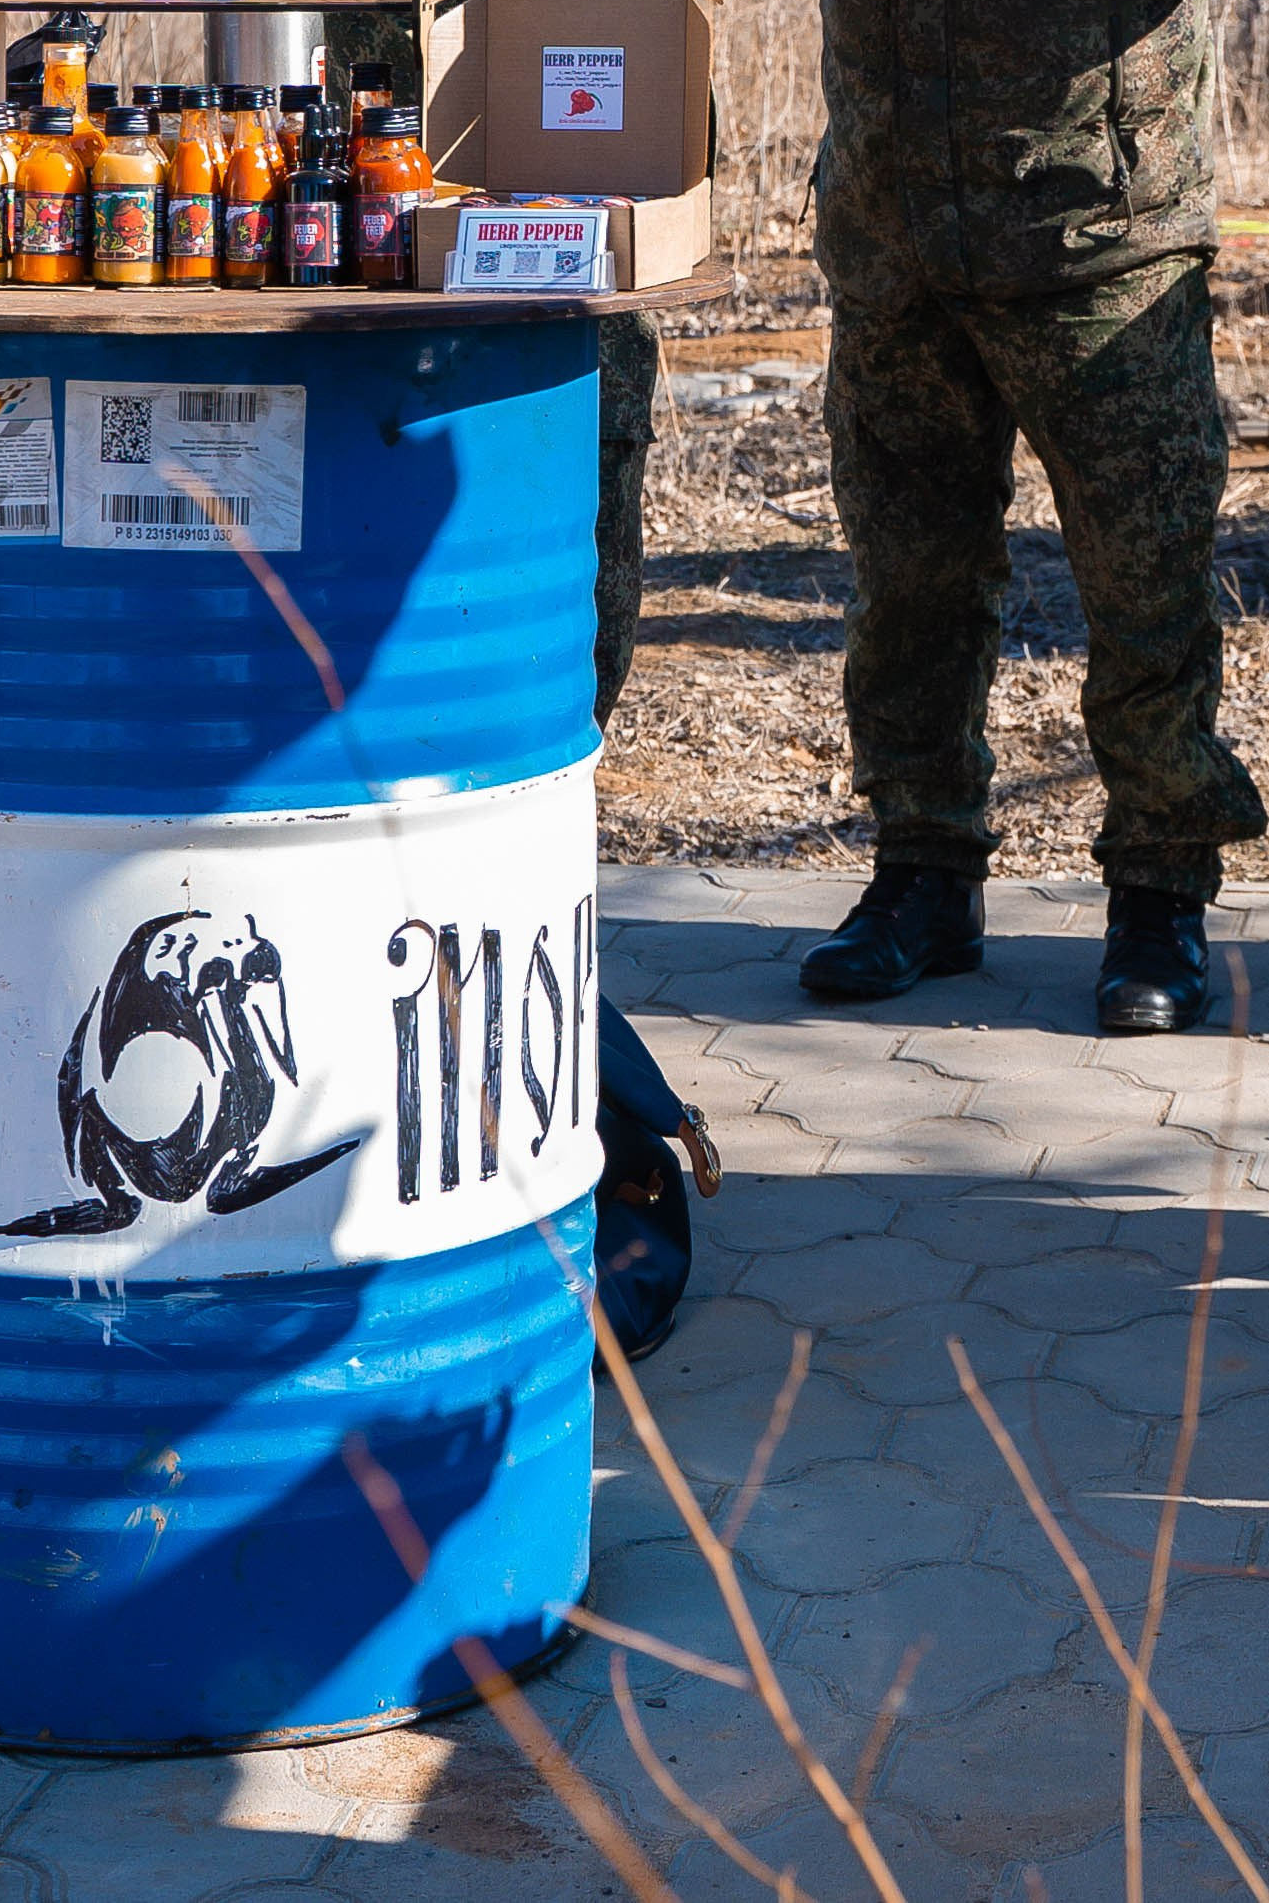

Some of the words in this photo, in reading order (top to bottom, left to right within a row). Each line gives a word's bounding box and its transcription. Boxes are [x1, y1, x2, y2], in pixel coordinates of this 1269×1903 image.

[544, 54, 575, 67] HERR
[577, 54, 623, 67] PEPPER
[477, 223, 519, 241] HERR
[522, 223, 584, 241] PEPPER
[116, 527, 122, 538] P
[126, 528, 132, 539] 8
[136, 528, 141, 539] 3
